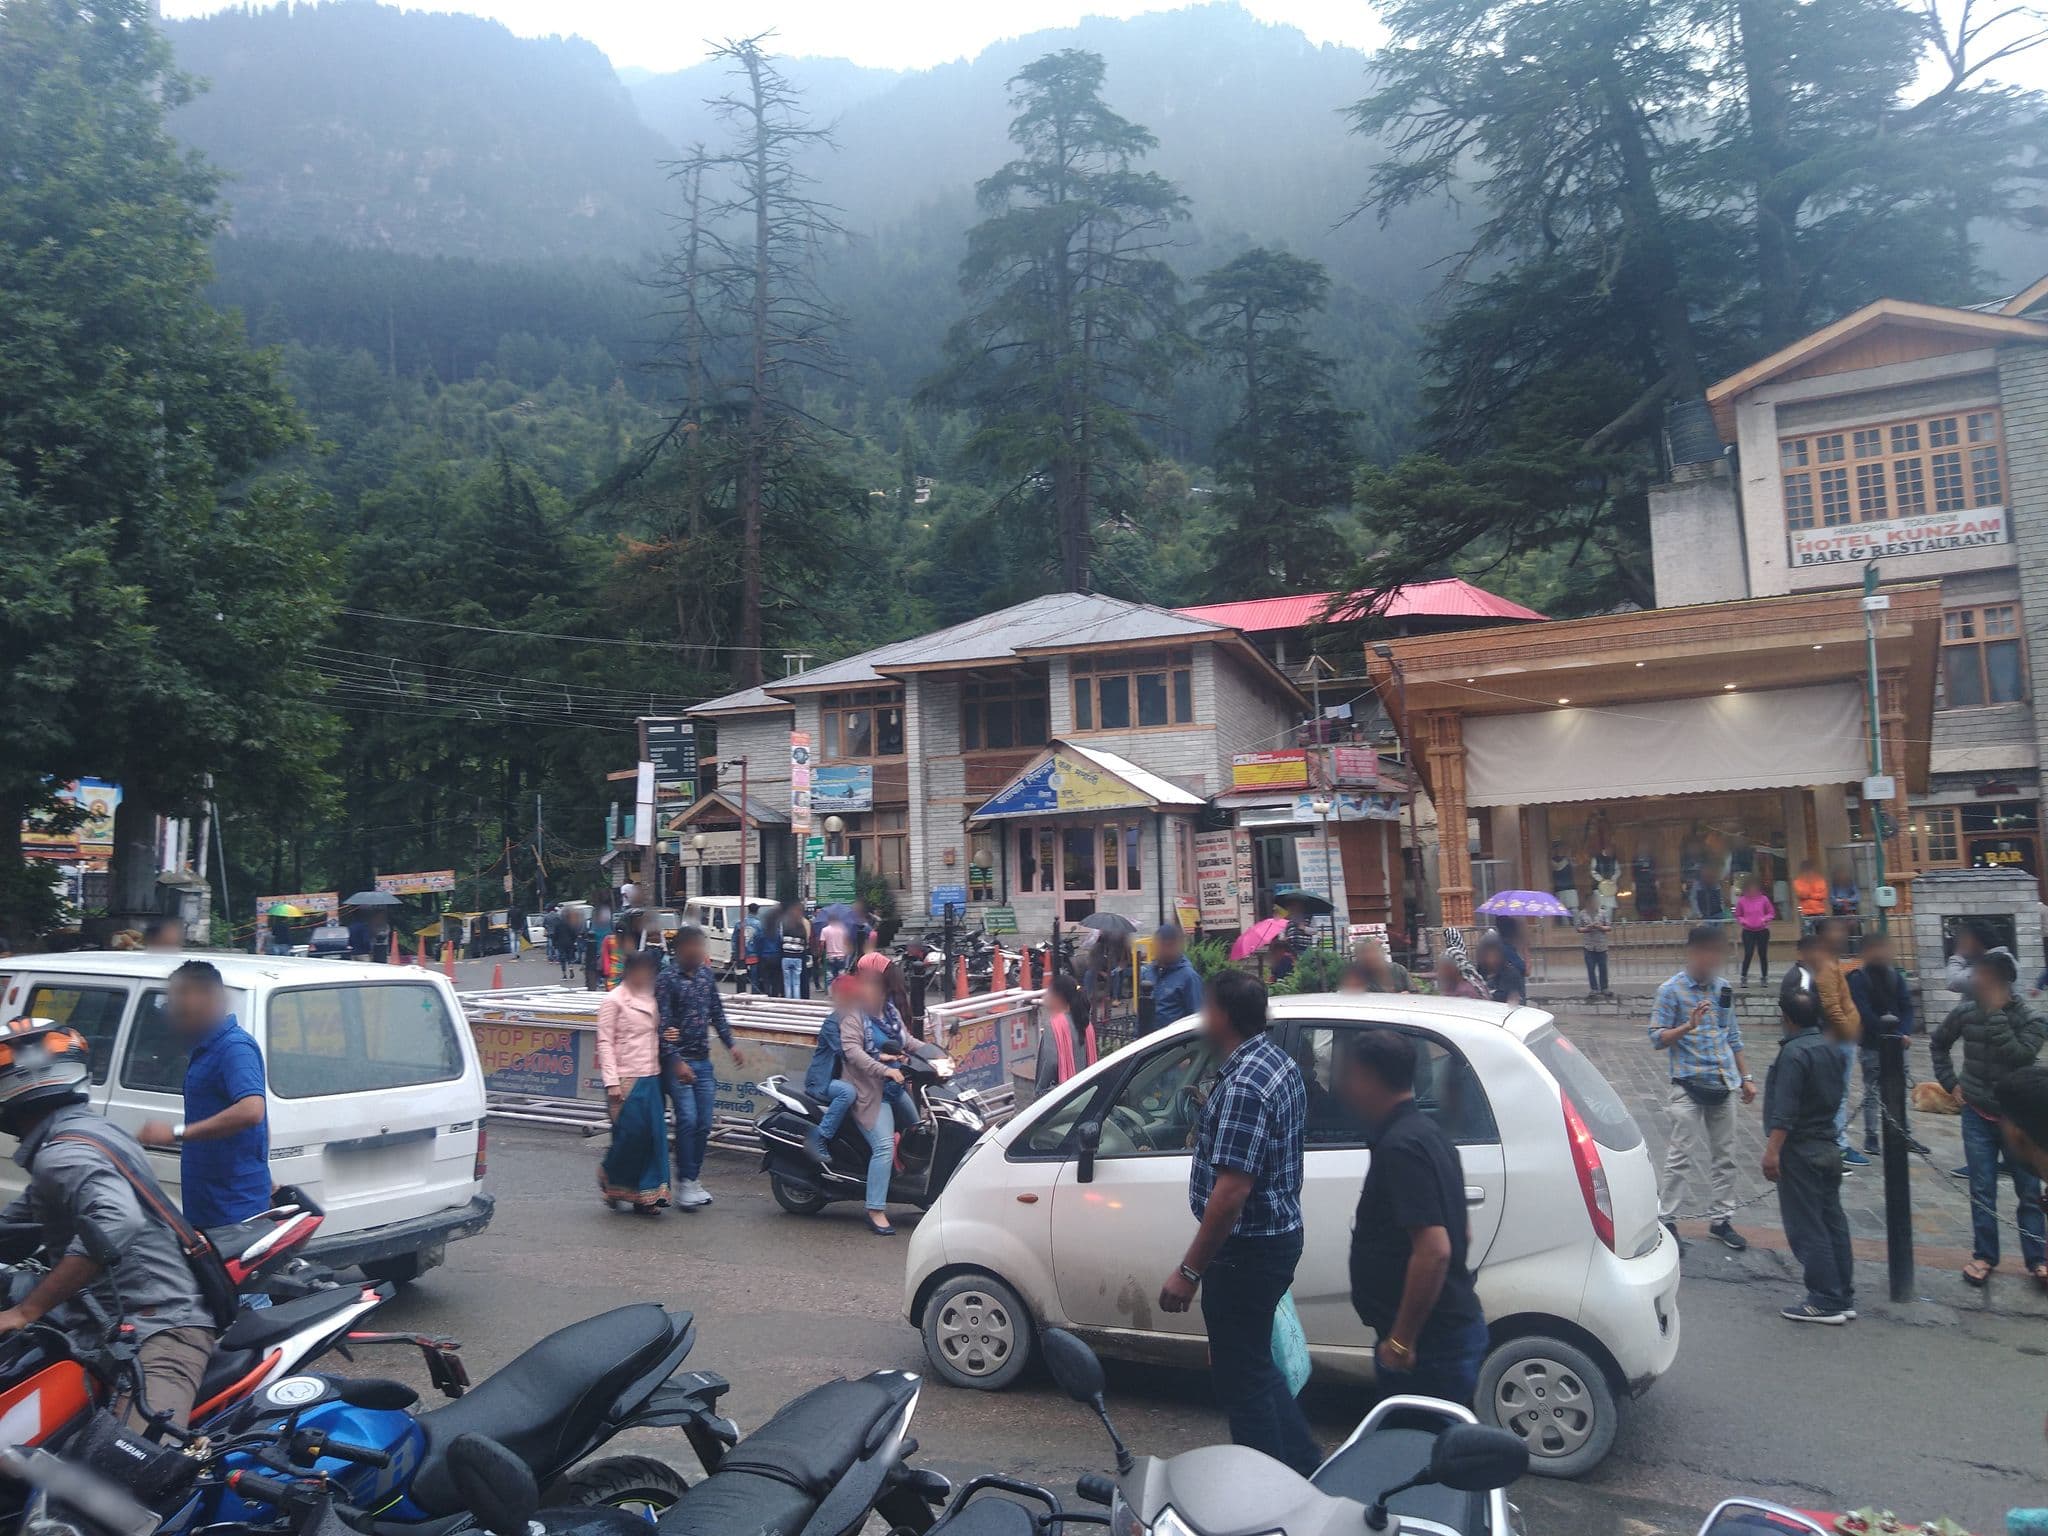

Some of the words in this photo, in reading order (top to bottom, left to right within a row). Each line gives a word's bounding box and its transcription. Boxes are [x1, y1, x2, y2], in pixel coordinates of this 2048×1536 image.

[1796, 534, 1877, 553] HOTEL
[1887, 518, 2000, 543] KUNZAM
[1833, 522, 1891, 536] HIMACHAL
[1903, 514, 1957, 527] TOURISM
[1801, 549, 1842, 564] BAR
[1849, 547, 1863, 559] &
[1872, 531, 1999, 557] RESTAURANT
[1985, 852, 2022, 863] BAR
[475, 1026, 524, 1046] STOP
[531, 1031, 572, 1053] FOR
[968, 1024, 996, 1046] FOR
[482, 1050, 574, 1076] HECKING
[115, 1439, 147, 1461] SUZUKI
